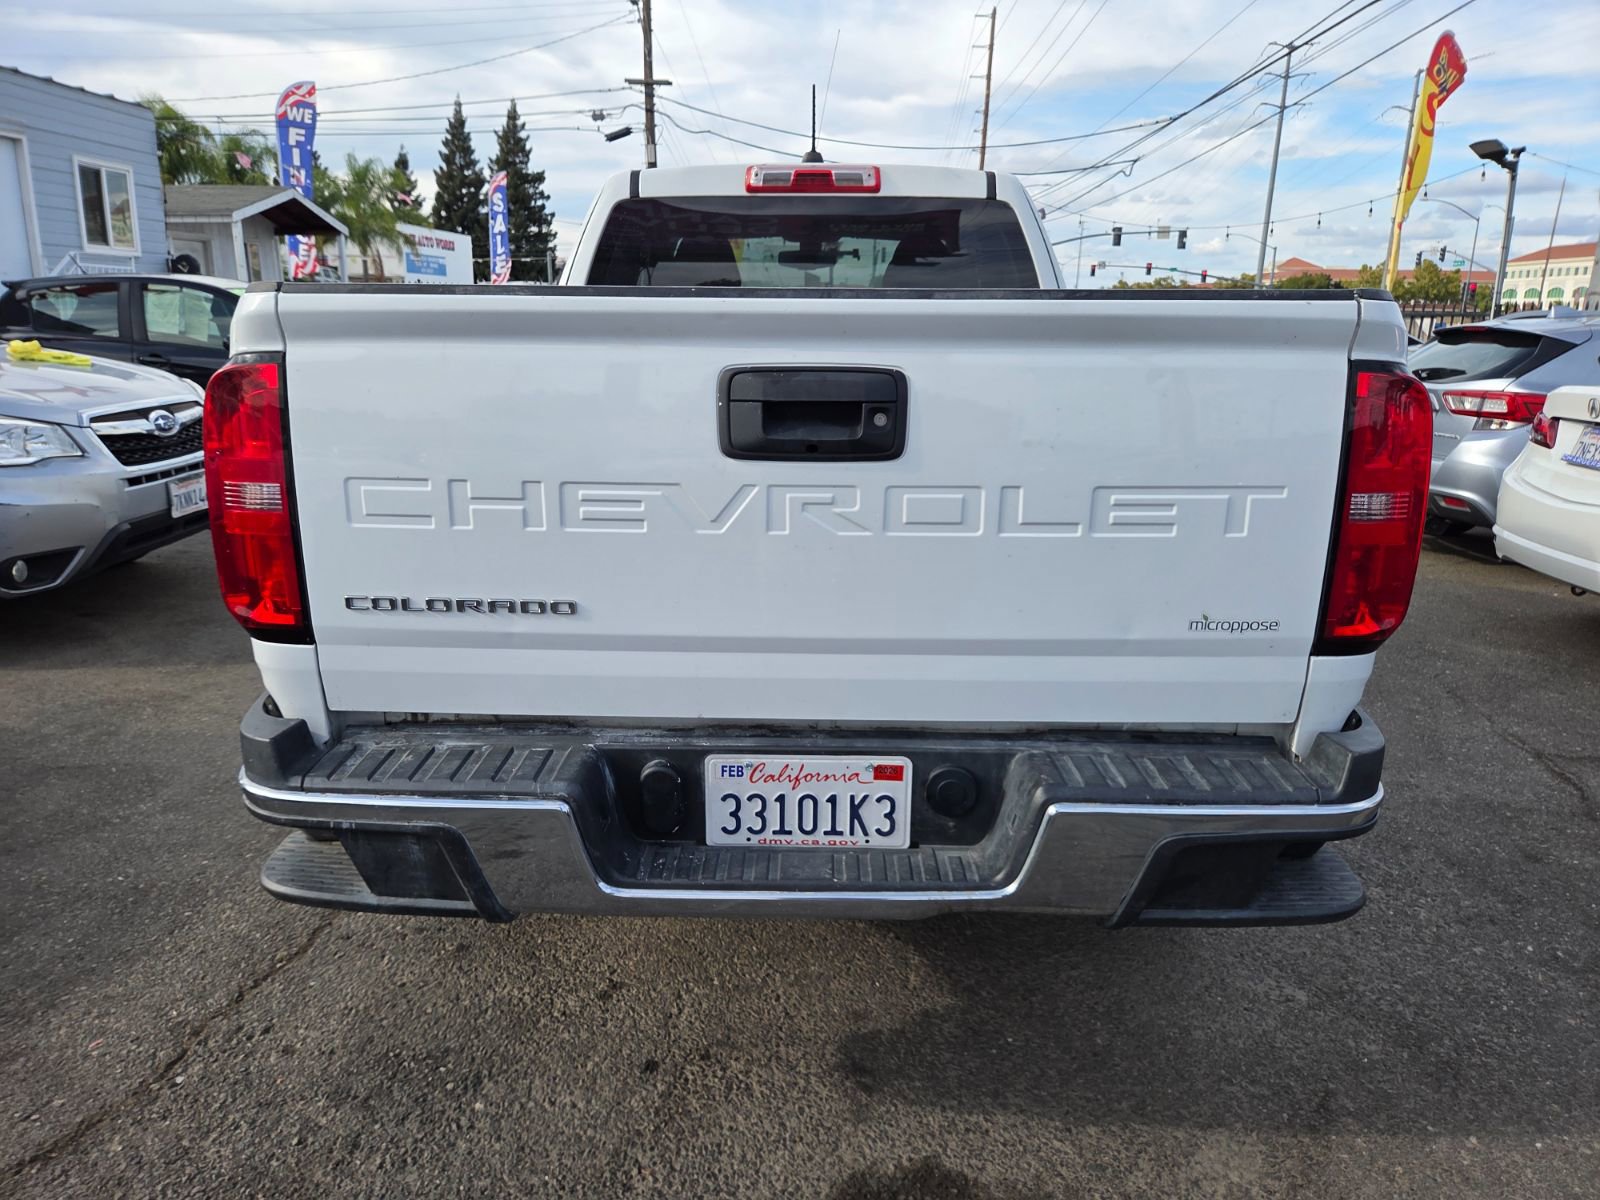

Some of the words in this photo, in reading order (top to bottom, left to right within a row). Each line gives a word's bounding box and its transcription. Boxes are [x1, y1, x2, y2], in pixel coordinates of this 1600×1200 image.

[286, 106, 313, 124] WE
[492, 192, 507, 274] SALE
[344, 476, 1288, 537] CHEVROLET
[344, 595, 577, 615] COLORADO
[1189, 614, 1279, 633] microppose
[721, 765, 745, 777] FEB
[750, 763, 874, 790] California
[720, 793, 896, 837] 33101K3
[757, 837, 860, 846] dmv.ca.gov
